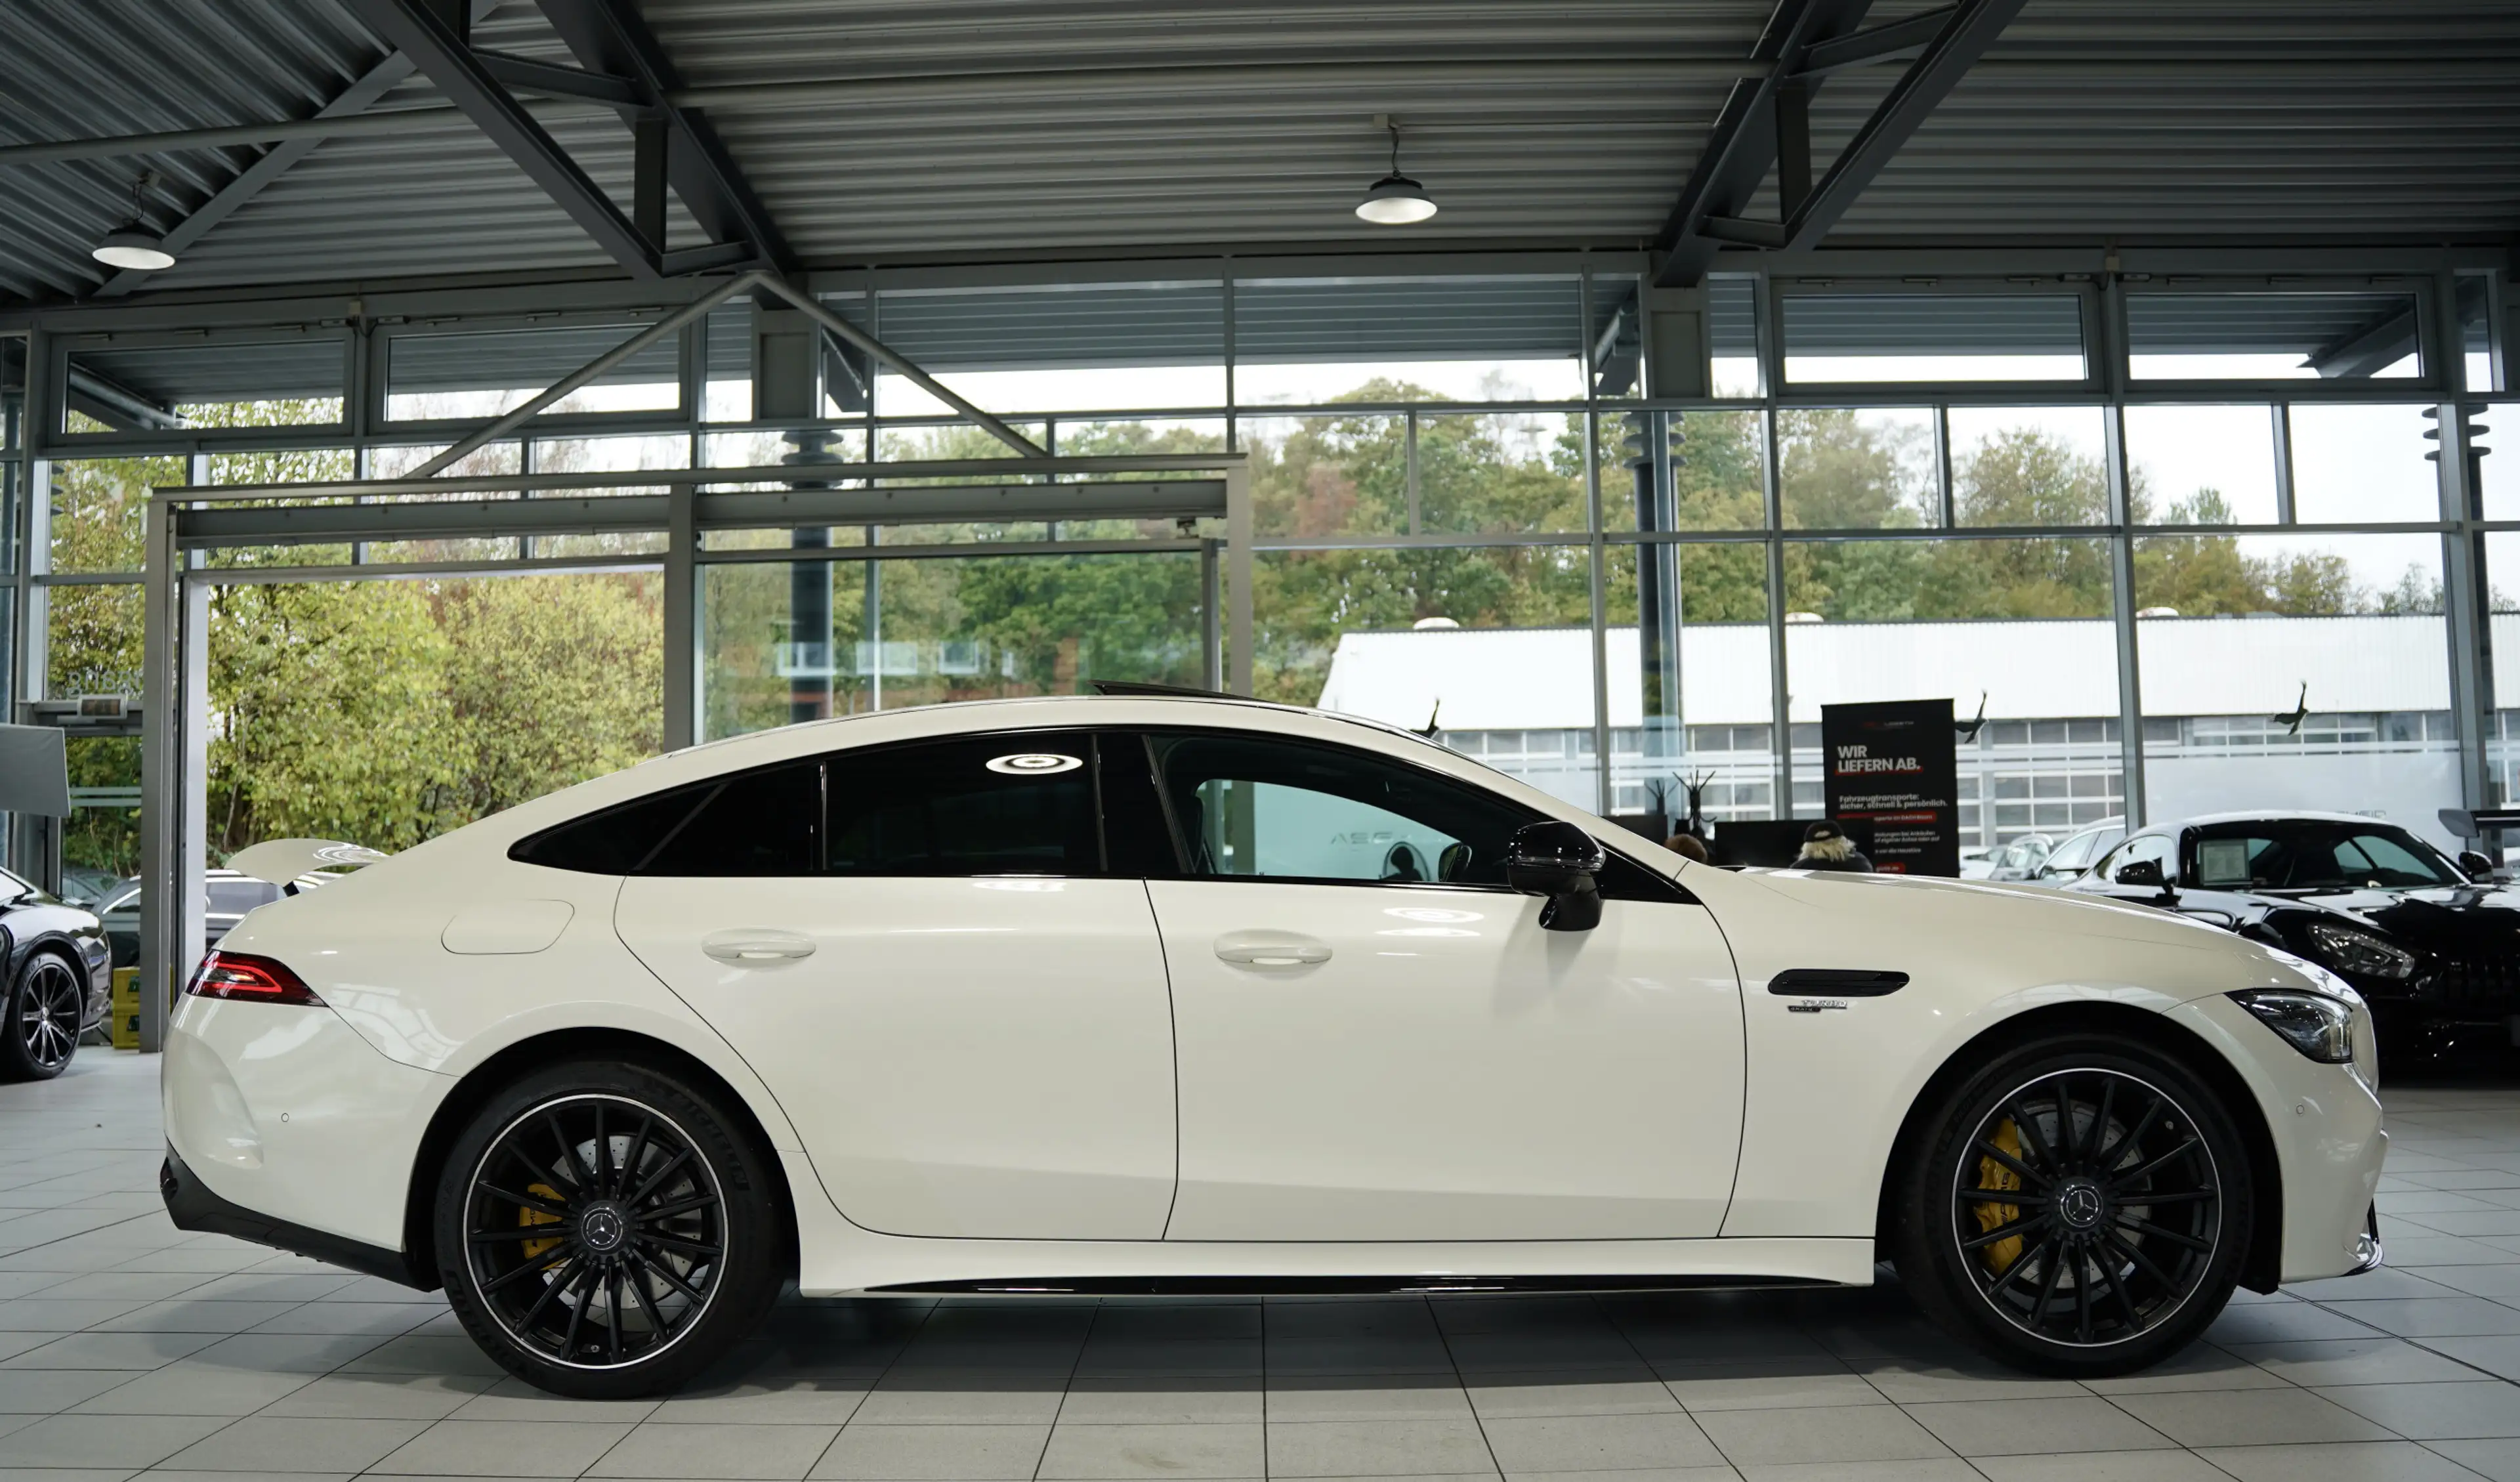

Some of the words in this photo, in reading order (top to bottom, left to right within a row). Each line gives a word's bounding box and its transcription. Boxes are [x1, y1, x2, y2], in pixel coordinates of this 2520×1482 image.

[1838, 745, 1867, 759] WIR
[1838, 758, 1893, 773] LIEFERN
[1895, 757, 1921, 771] AB.
[1839, 794, 1920, 804] Fahrzeugtransporte:
[1840, 801, 1866, 809] sicher,
[1904, 799, 1948, 809] persönlich.
[669, 1091, 749, 1187] MICHELIN
